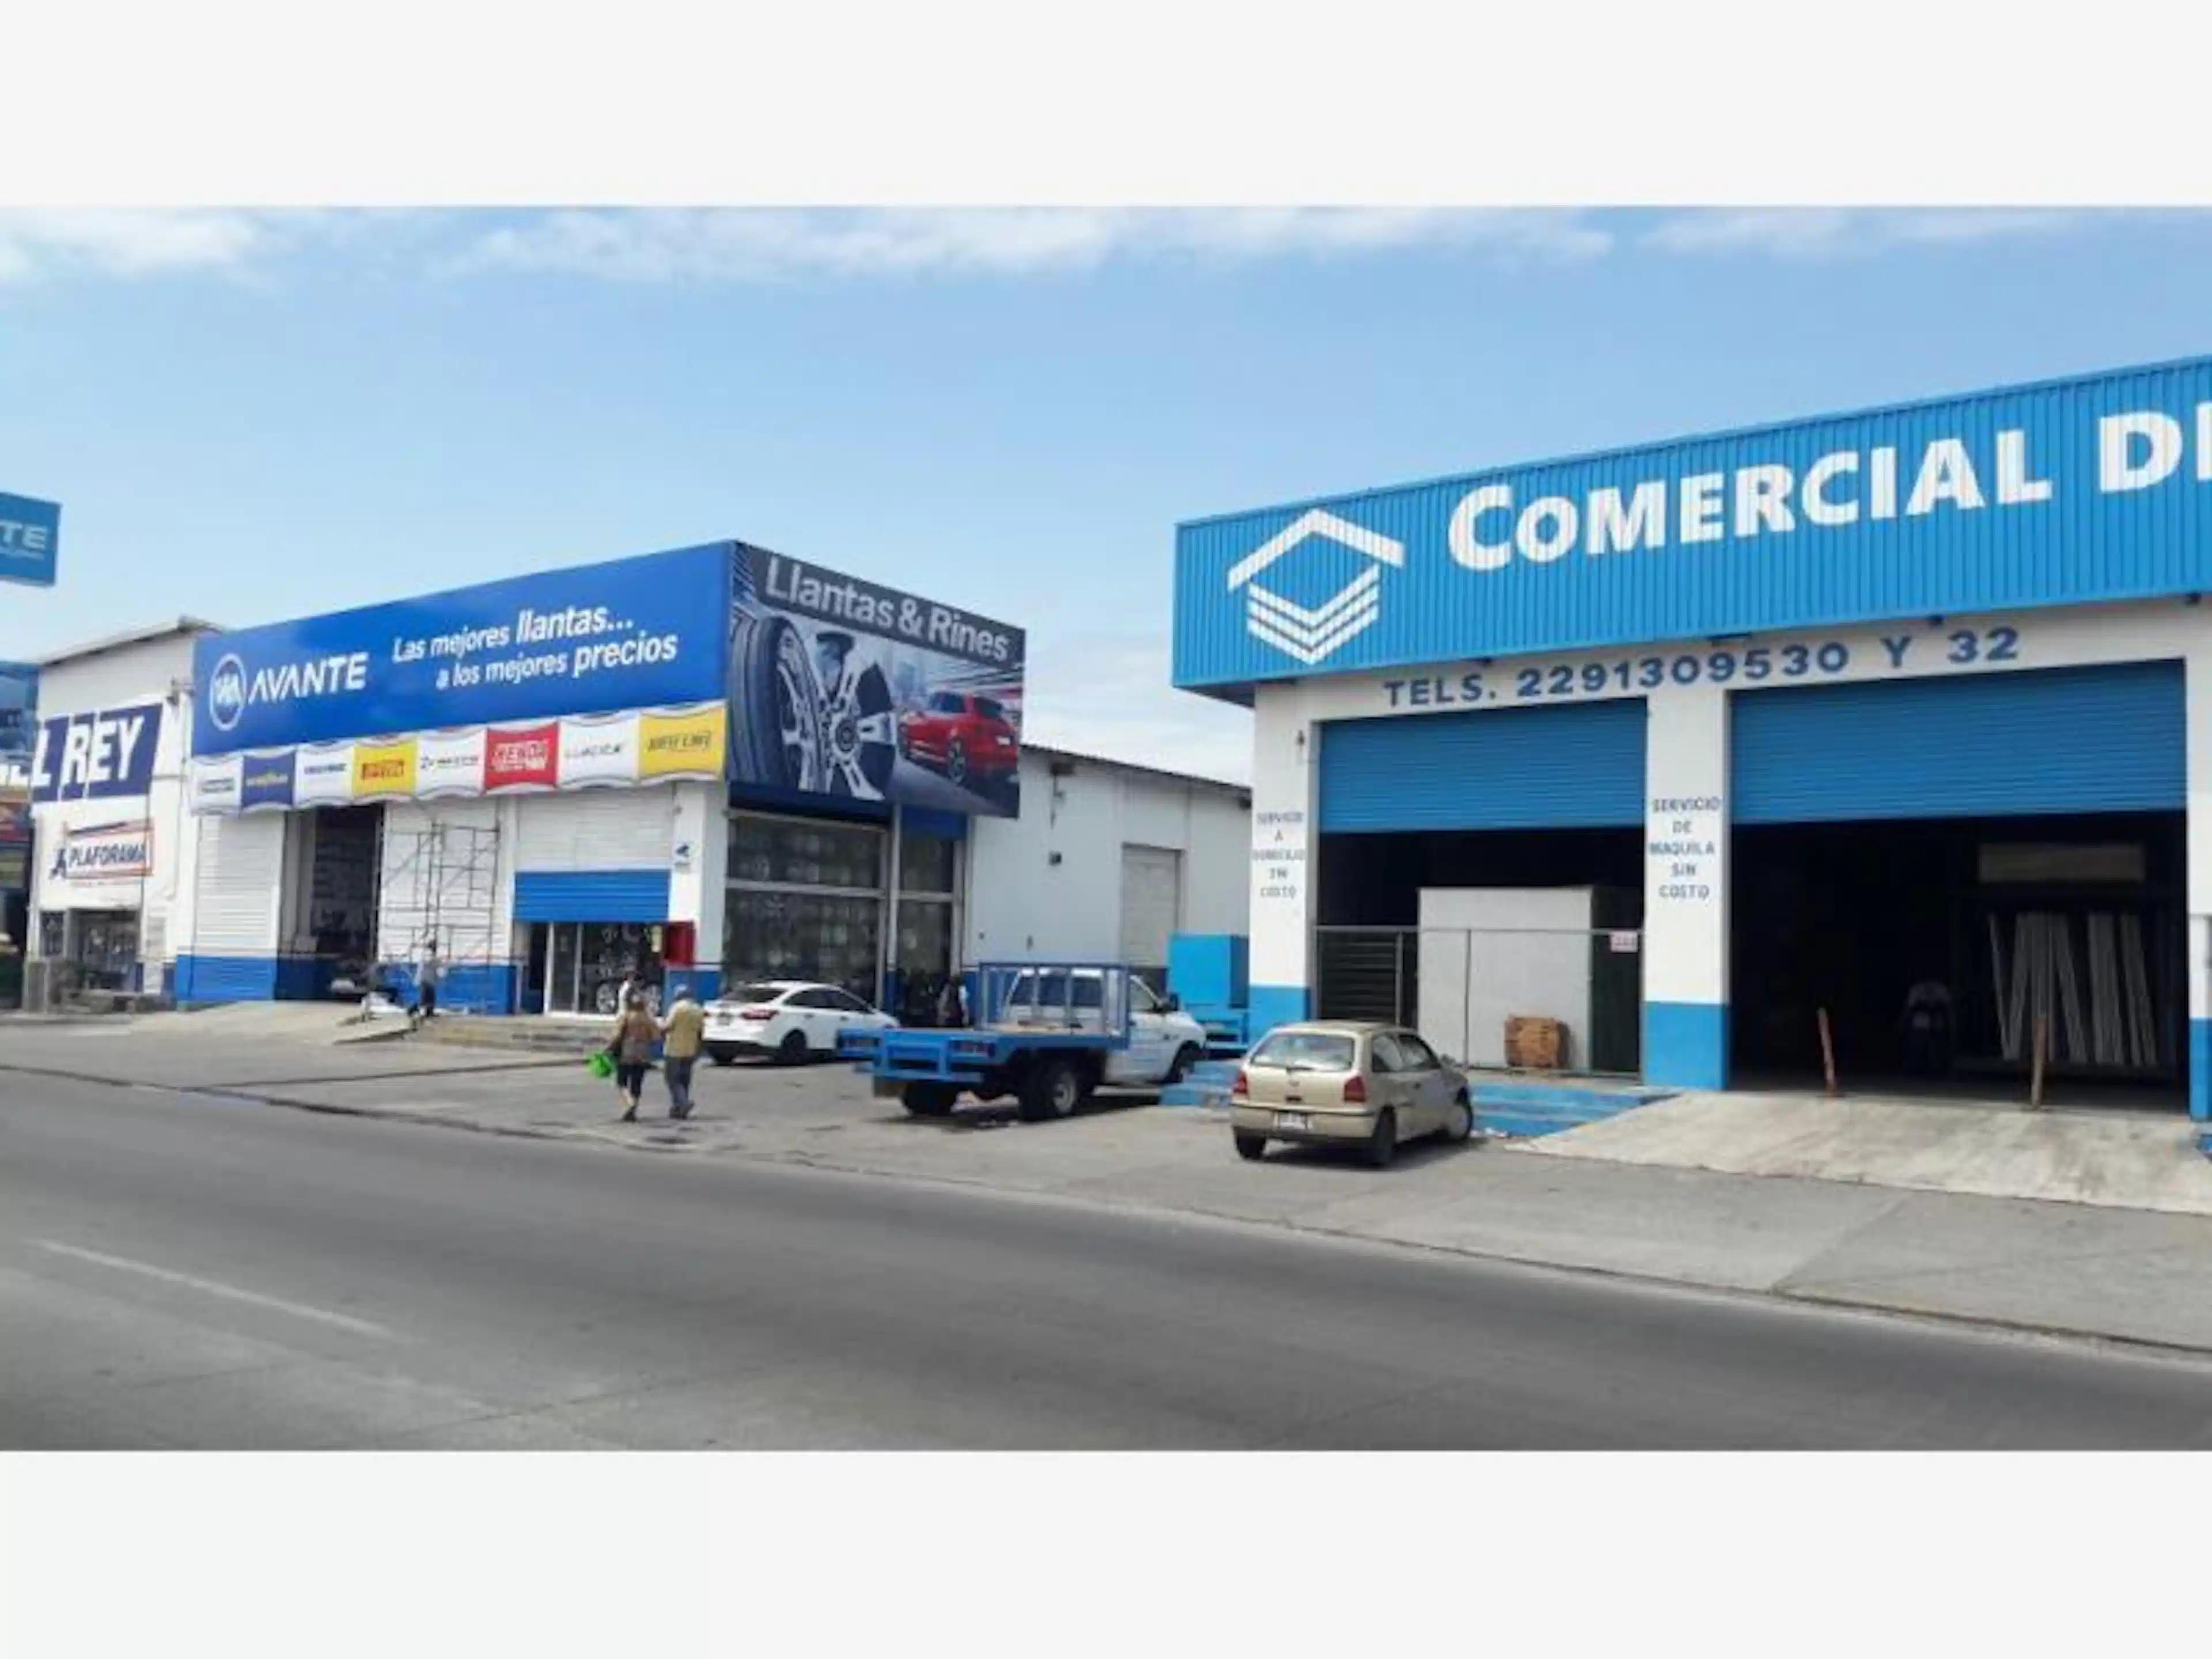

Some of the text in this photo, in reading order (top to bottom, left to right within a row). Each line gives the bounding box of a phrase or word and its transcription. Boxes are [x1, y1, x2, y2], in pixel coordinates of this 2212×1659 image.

[1448, 429, 2052, 571] COMERCIAL
[392, 605, 634, 663] Las mejores llantas...
[765, 556, 1009, 662] Llantas & Rines
[248, 652, 369, 704] AVANTE
[436, 630, 679, 690] a los mejores precios
[1385, 626, 2019, 707] TELS. 2291309530 Y 32
[60, 715, 145, 787] REY
[1652, 796, 1720, 813] SERVICIO
[1672, 821, 1692, 834] DE
[1658, 884, 1710, 899] COSTO
[1672, 862, 1697, 876] SIN
